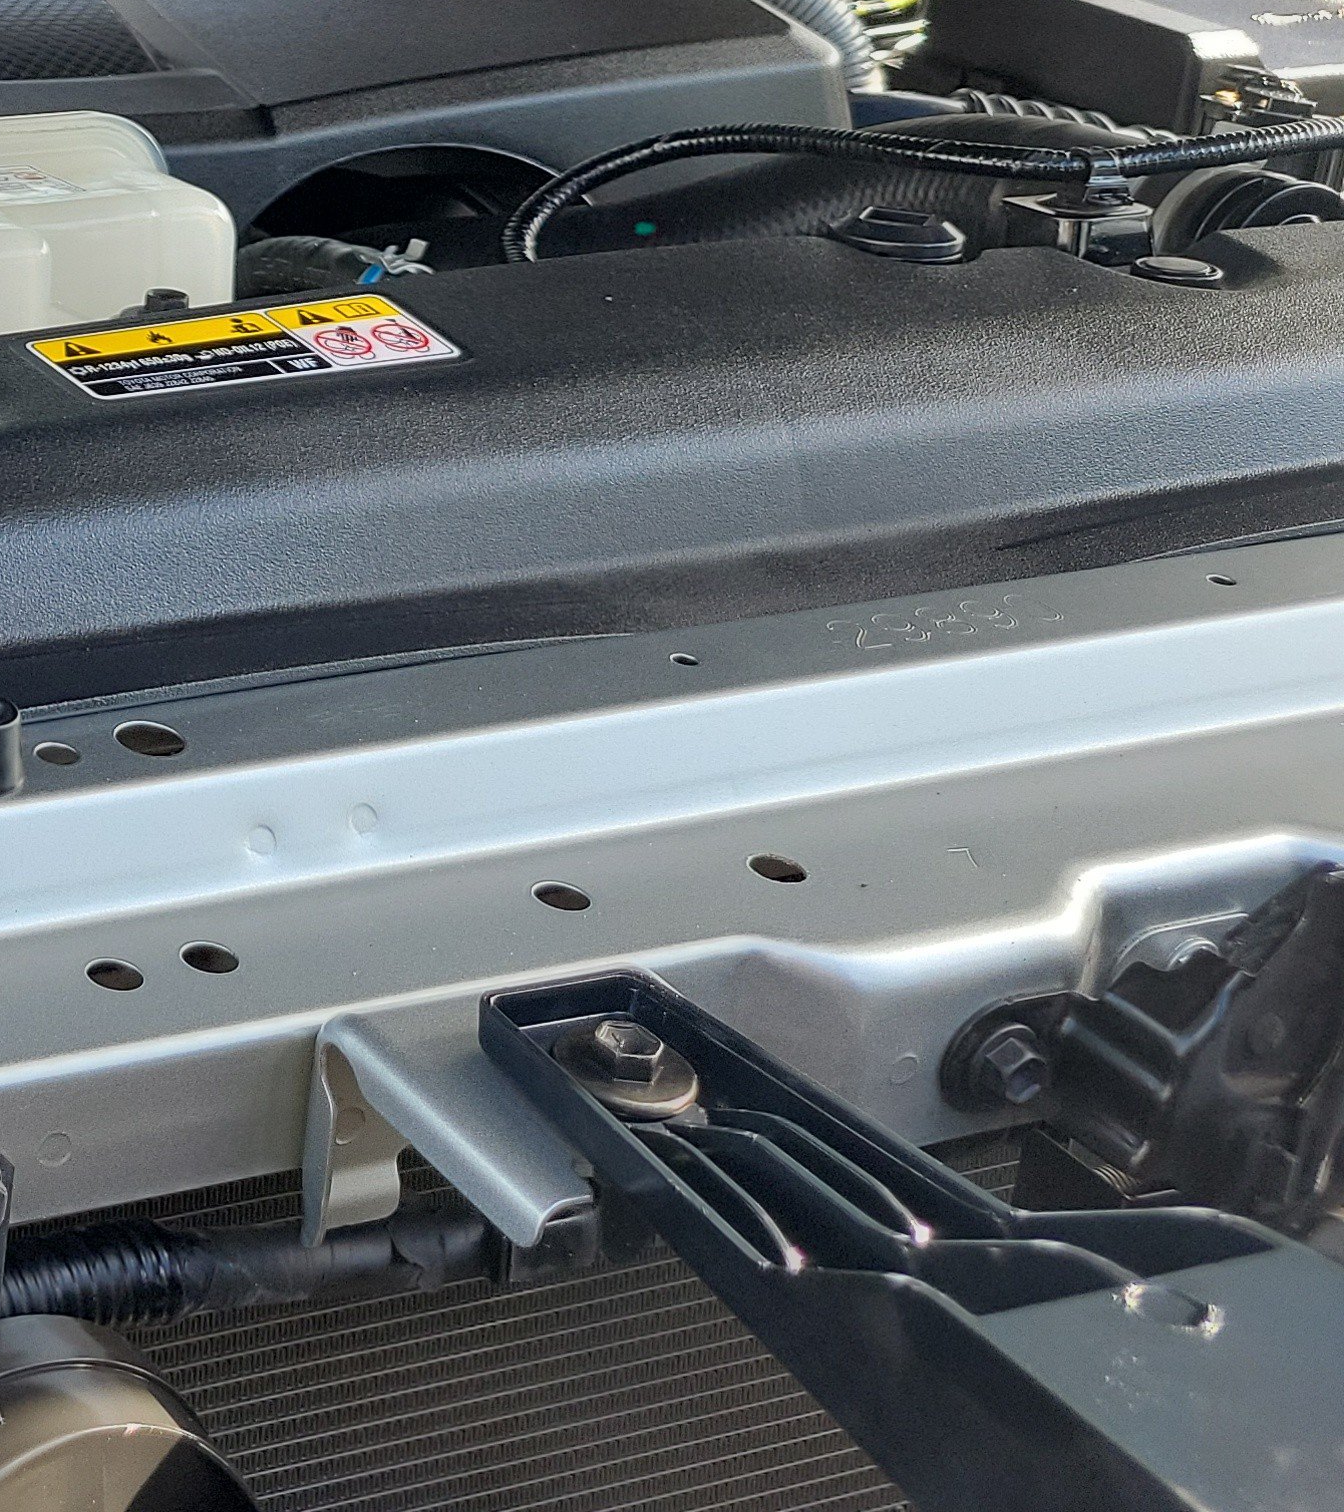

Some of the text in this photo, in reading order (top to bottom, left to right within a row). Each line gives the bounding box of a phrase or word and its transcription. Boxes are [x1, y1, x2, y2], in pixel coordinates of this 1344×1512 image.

[286, 357, 319, 370] WF
[117, 376, 152, 386] TOYOTA
[151, 372, 182, 382] MOTOR
